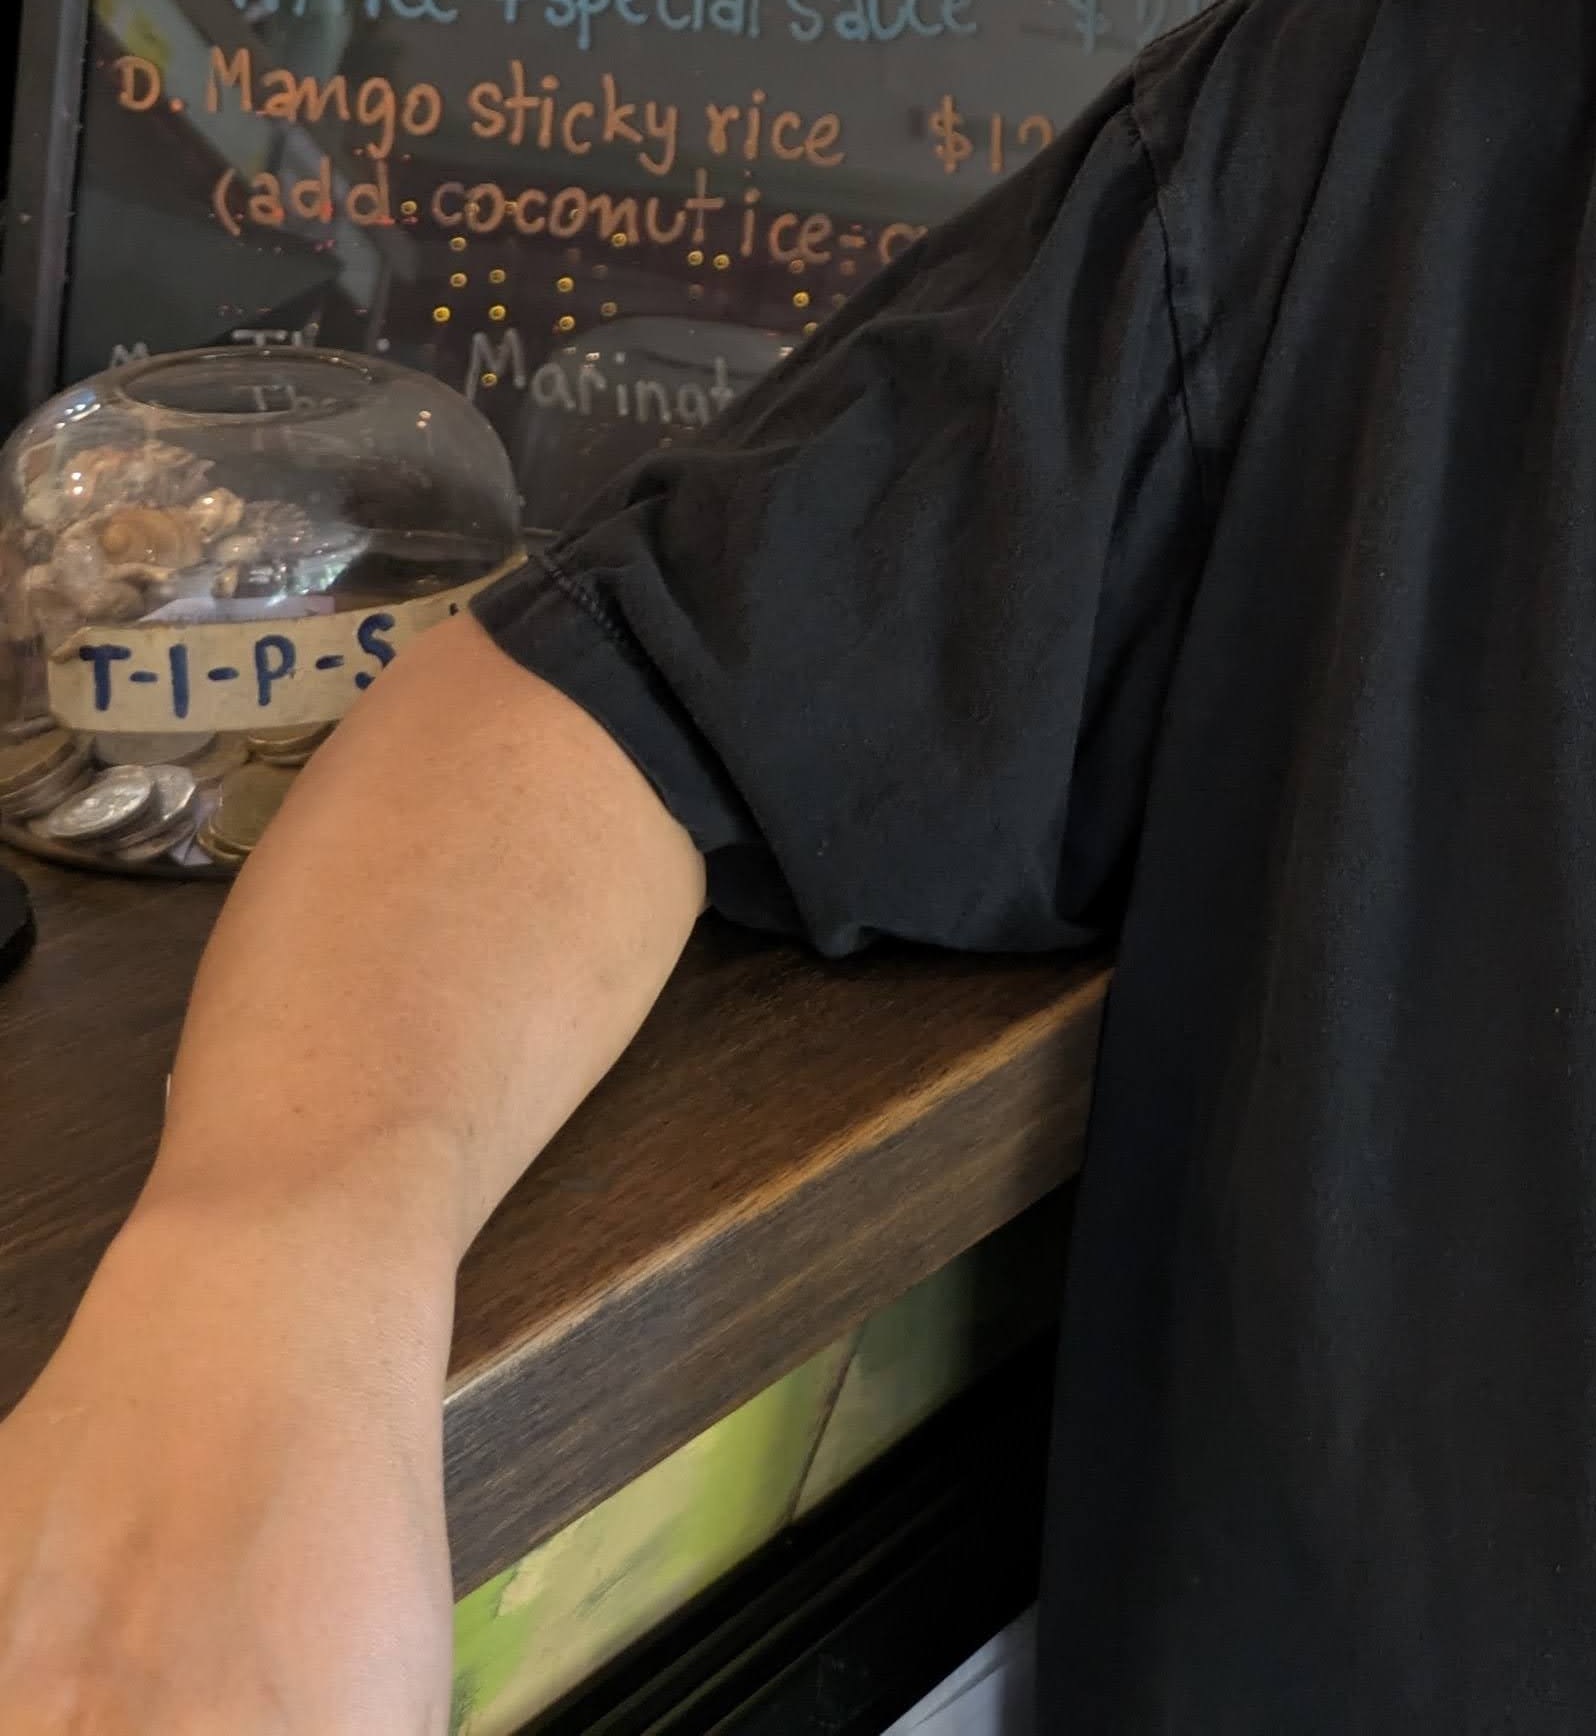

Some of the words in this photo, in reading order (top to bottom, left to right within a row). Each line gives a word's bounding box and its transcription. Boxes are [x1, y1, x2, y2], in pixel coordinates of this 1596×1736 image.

[115, 55, 185, 113] D.
[204, 46, 443, 158] Mango
[467, 58, 678, 176] sticky
[706, 88, 846, 166] rice
[213, 156, 396, 237] (add
[430, 168, 725, 248] coconut
